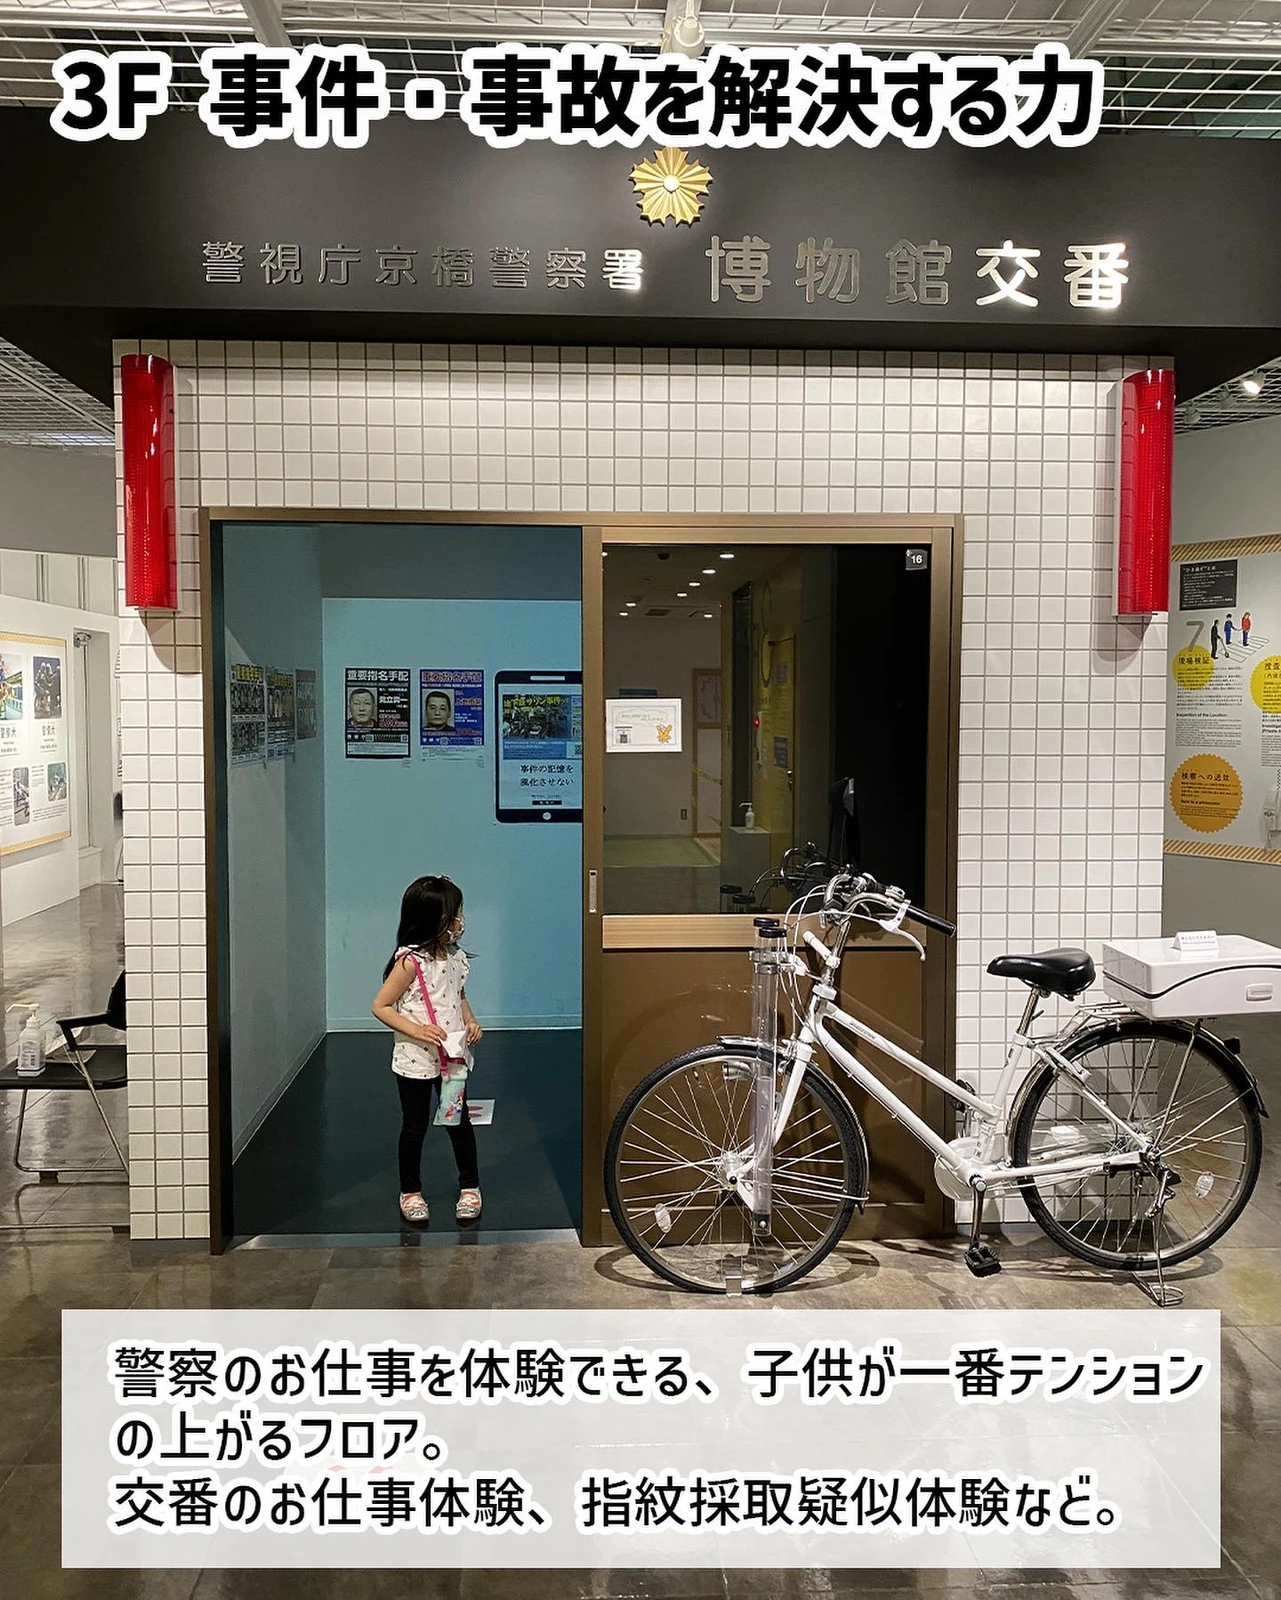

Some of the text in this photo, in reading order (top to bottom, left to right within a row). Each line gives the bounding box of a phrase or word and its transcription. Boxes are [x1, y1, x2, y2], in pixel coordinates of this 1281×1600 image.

[202, 235, 1130, 308] 警視庁京橋警察署 博物館交番
[911, 554, 923, 564] 16
[1186, 620, 1205, 652] 7
[347, 669, 409, 682] 重要指名手配
[520, 764, 574, 774] 事件の記憶を
[520, 778, 574, 787] 風化させない
